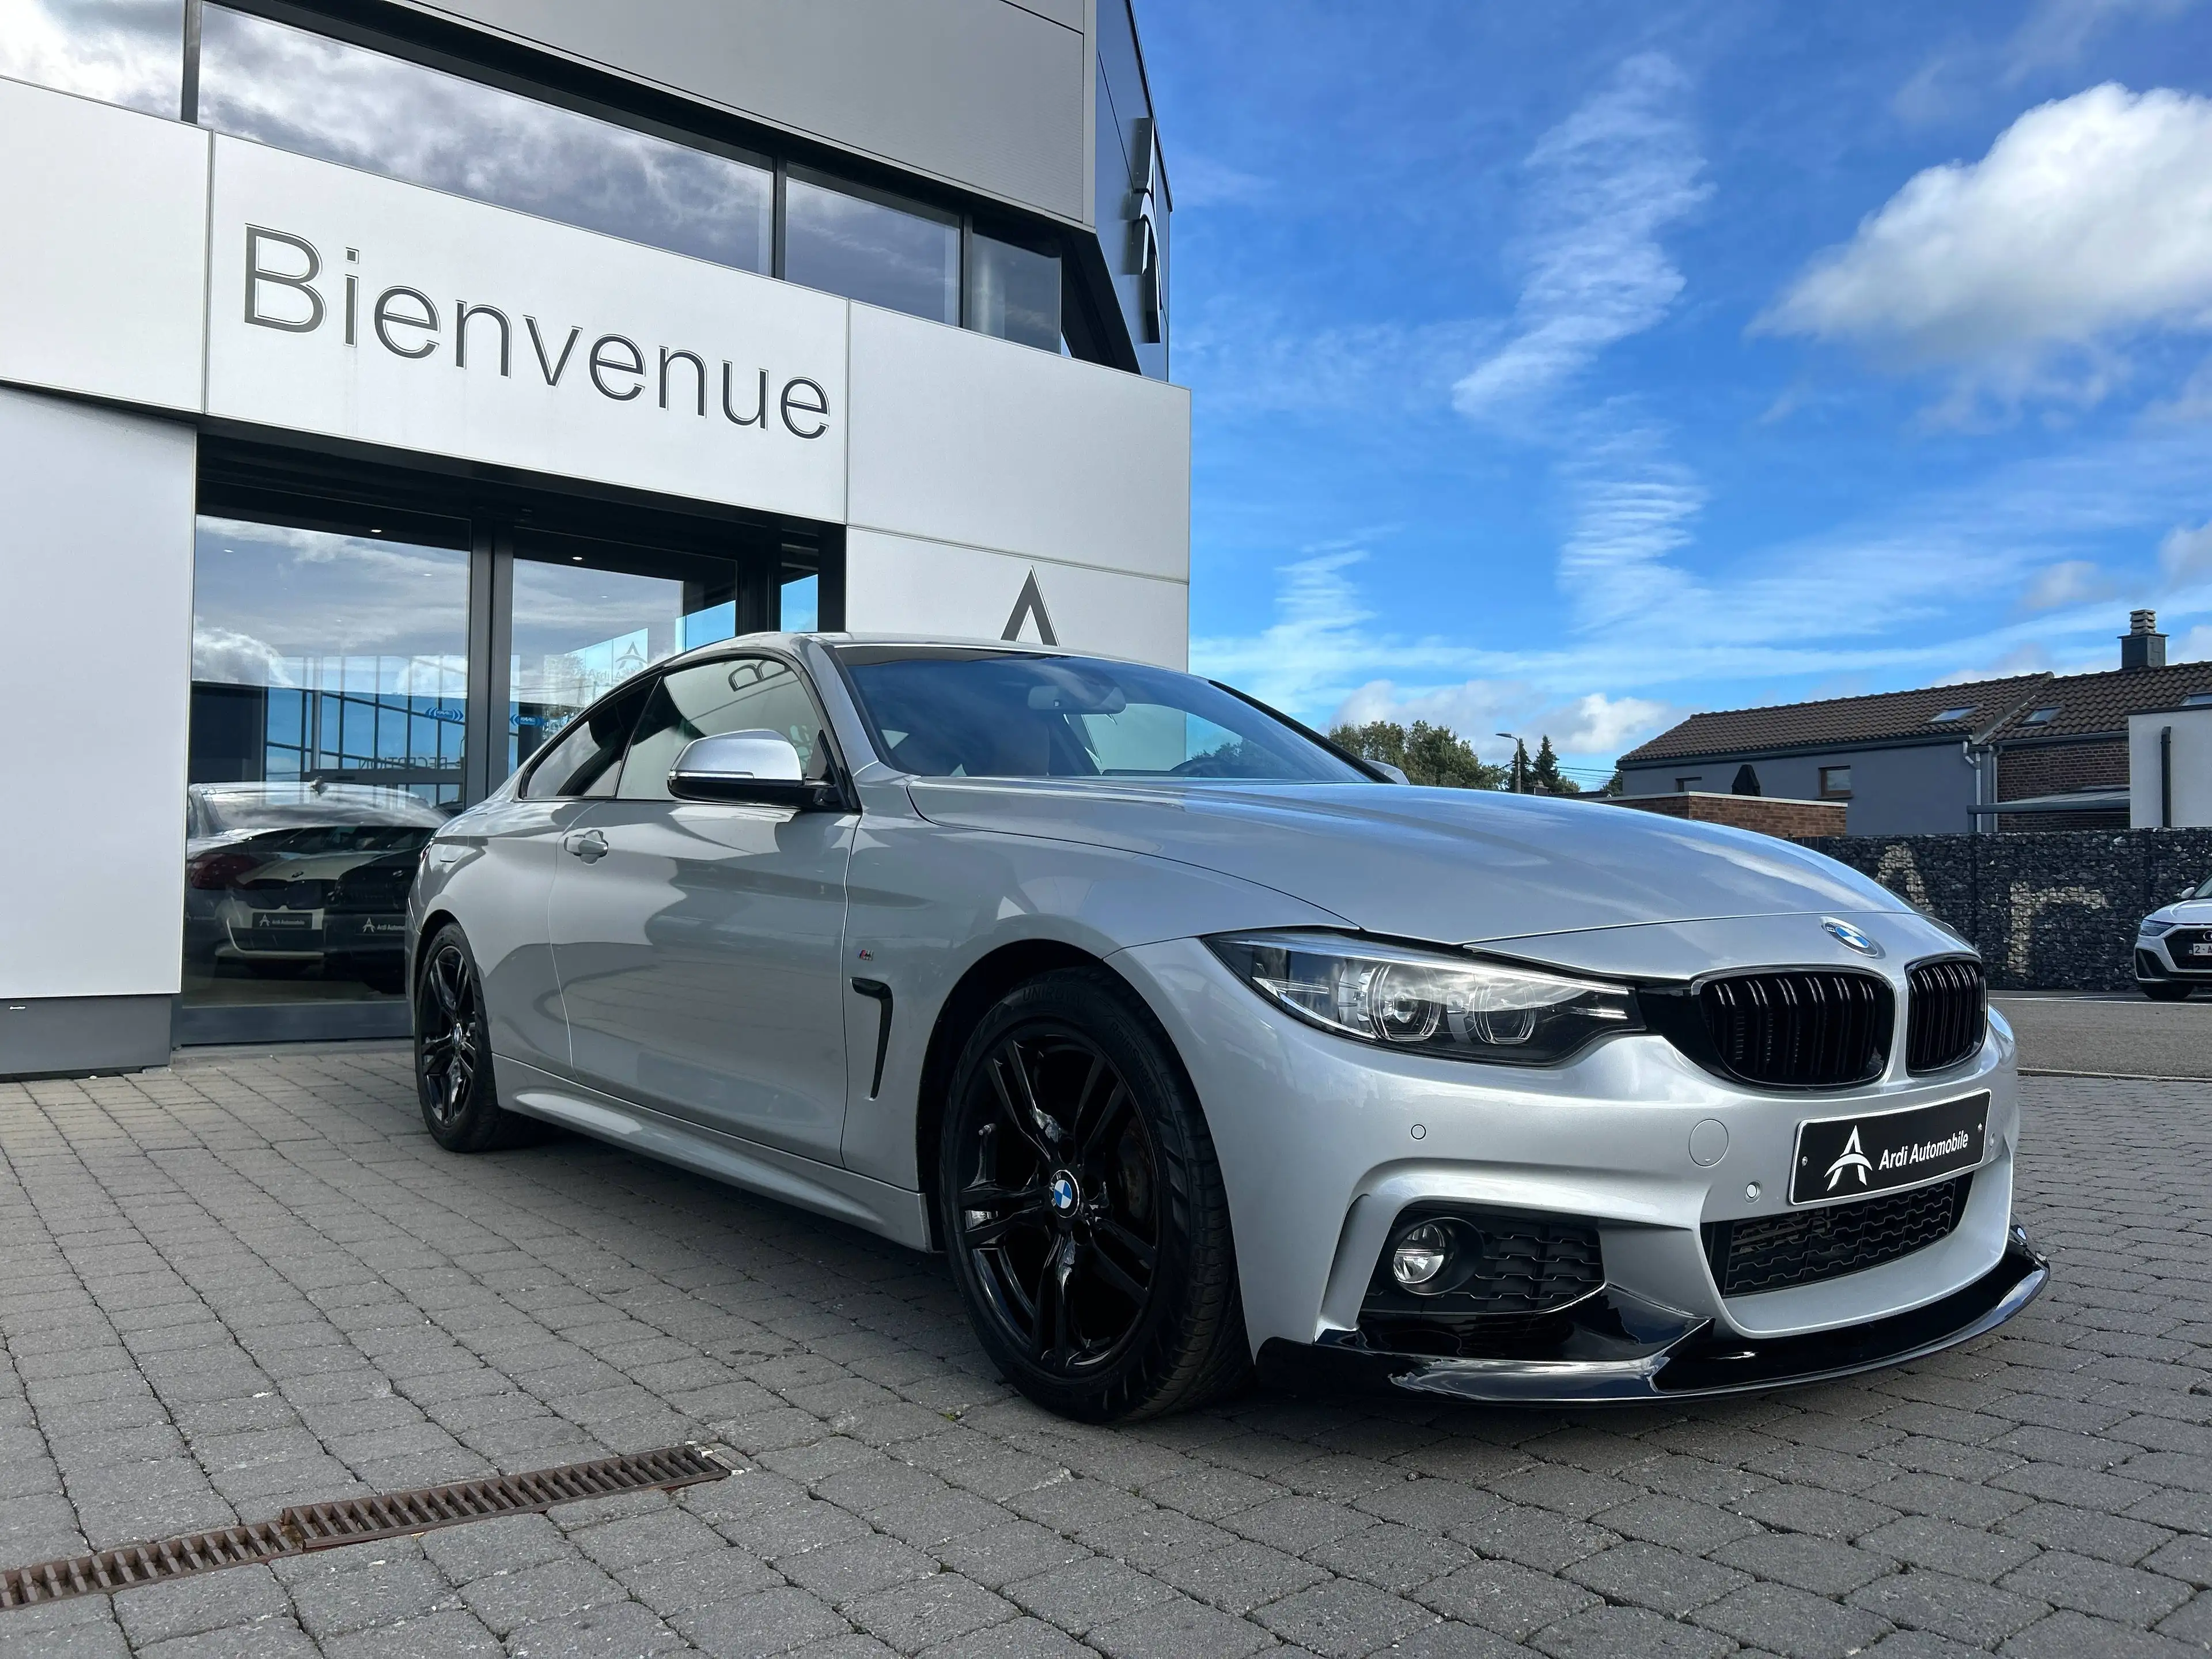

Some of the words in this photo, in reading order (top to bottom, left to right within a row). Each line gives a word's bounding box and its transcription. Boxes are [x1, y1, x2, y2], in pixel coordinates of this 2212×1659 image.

[244, 222, 830, 440] Bienvenue
[1878, 1145, 1908, 1171] Ardi
[1909, 1130, 1969, 1165] Automobile
